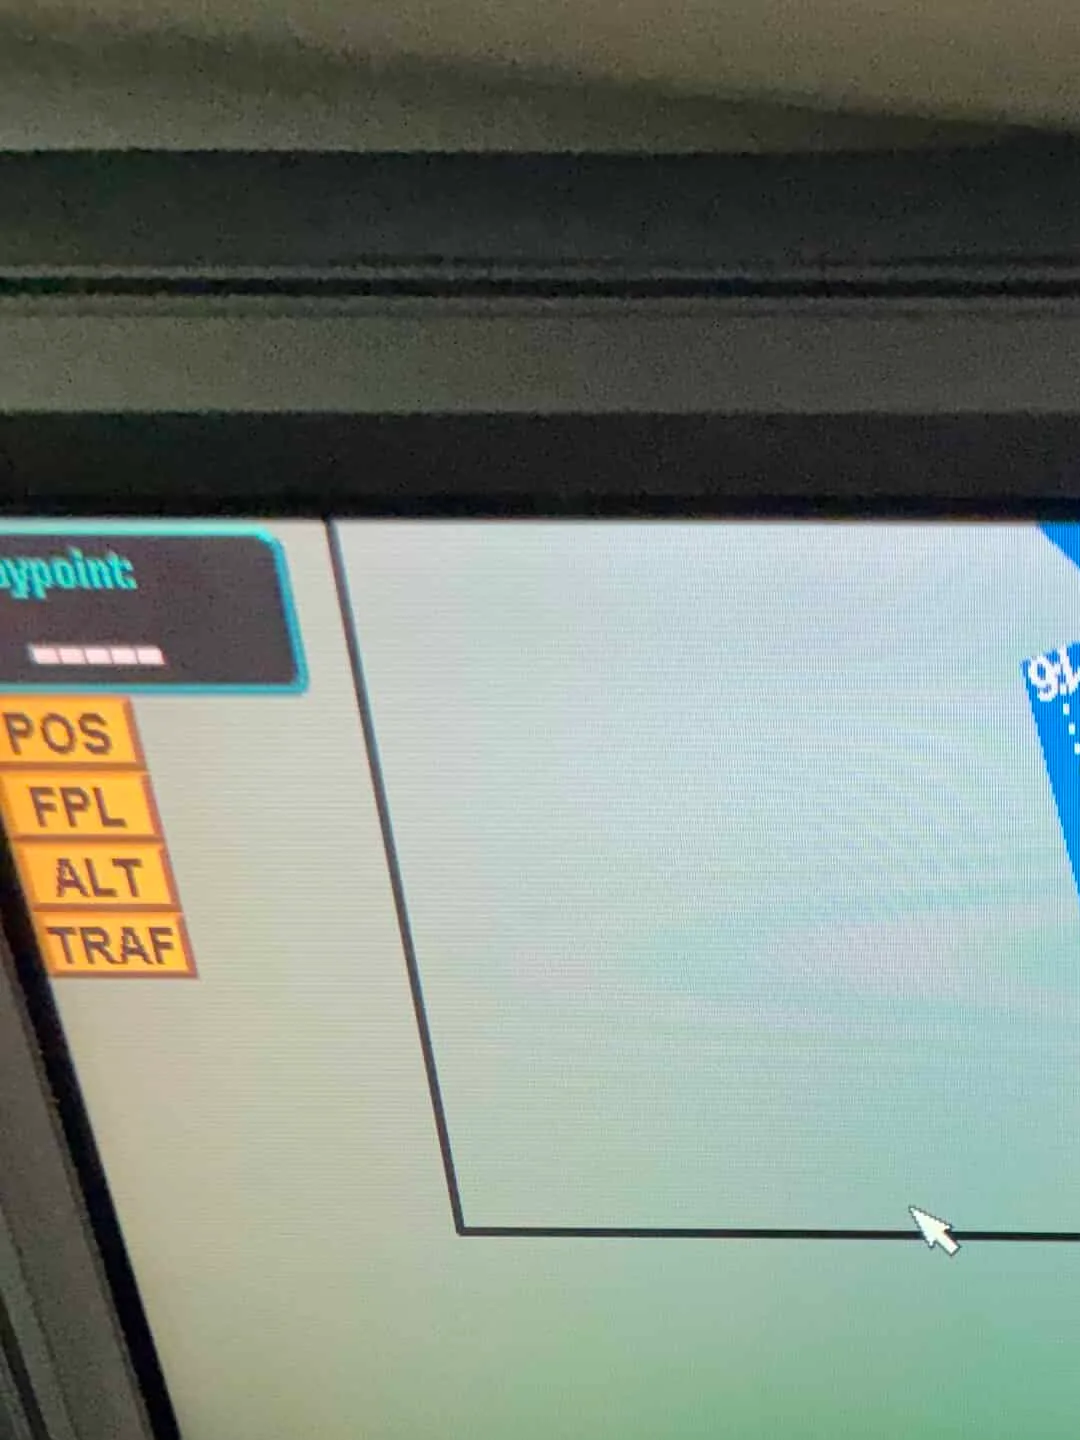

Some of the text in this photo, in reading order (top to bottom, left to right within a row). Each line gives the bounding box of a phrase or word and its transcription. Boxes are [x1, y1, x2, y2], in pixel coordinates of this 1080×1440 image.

[2, 711, 113, 756] POS
[28, 786, 127, 829] FPL
[56, 858, 143, 898] ALT
[47, 926, 175, 966] TRAF
